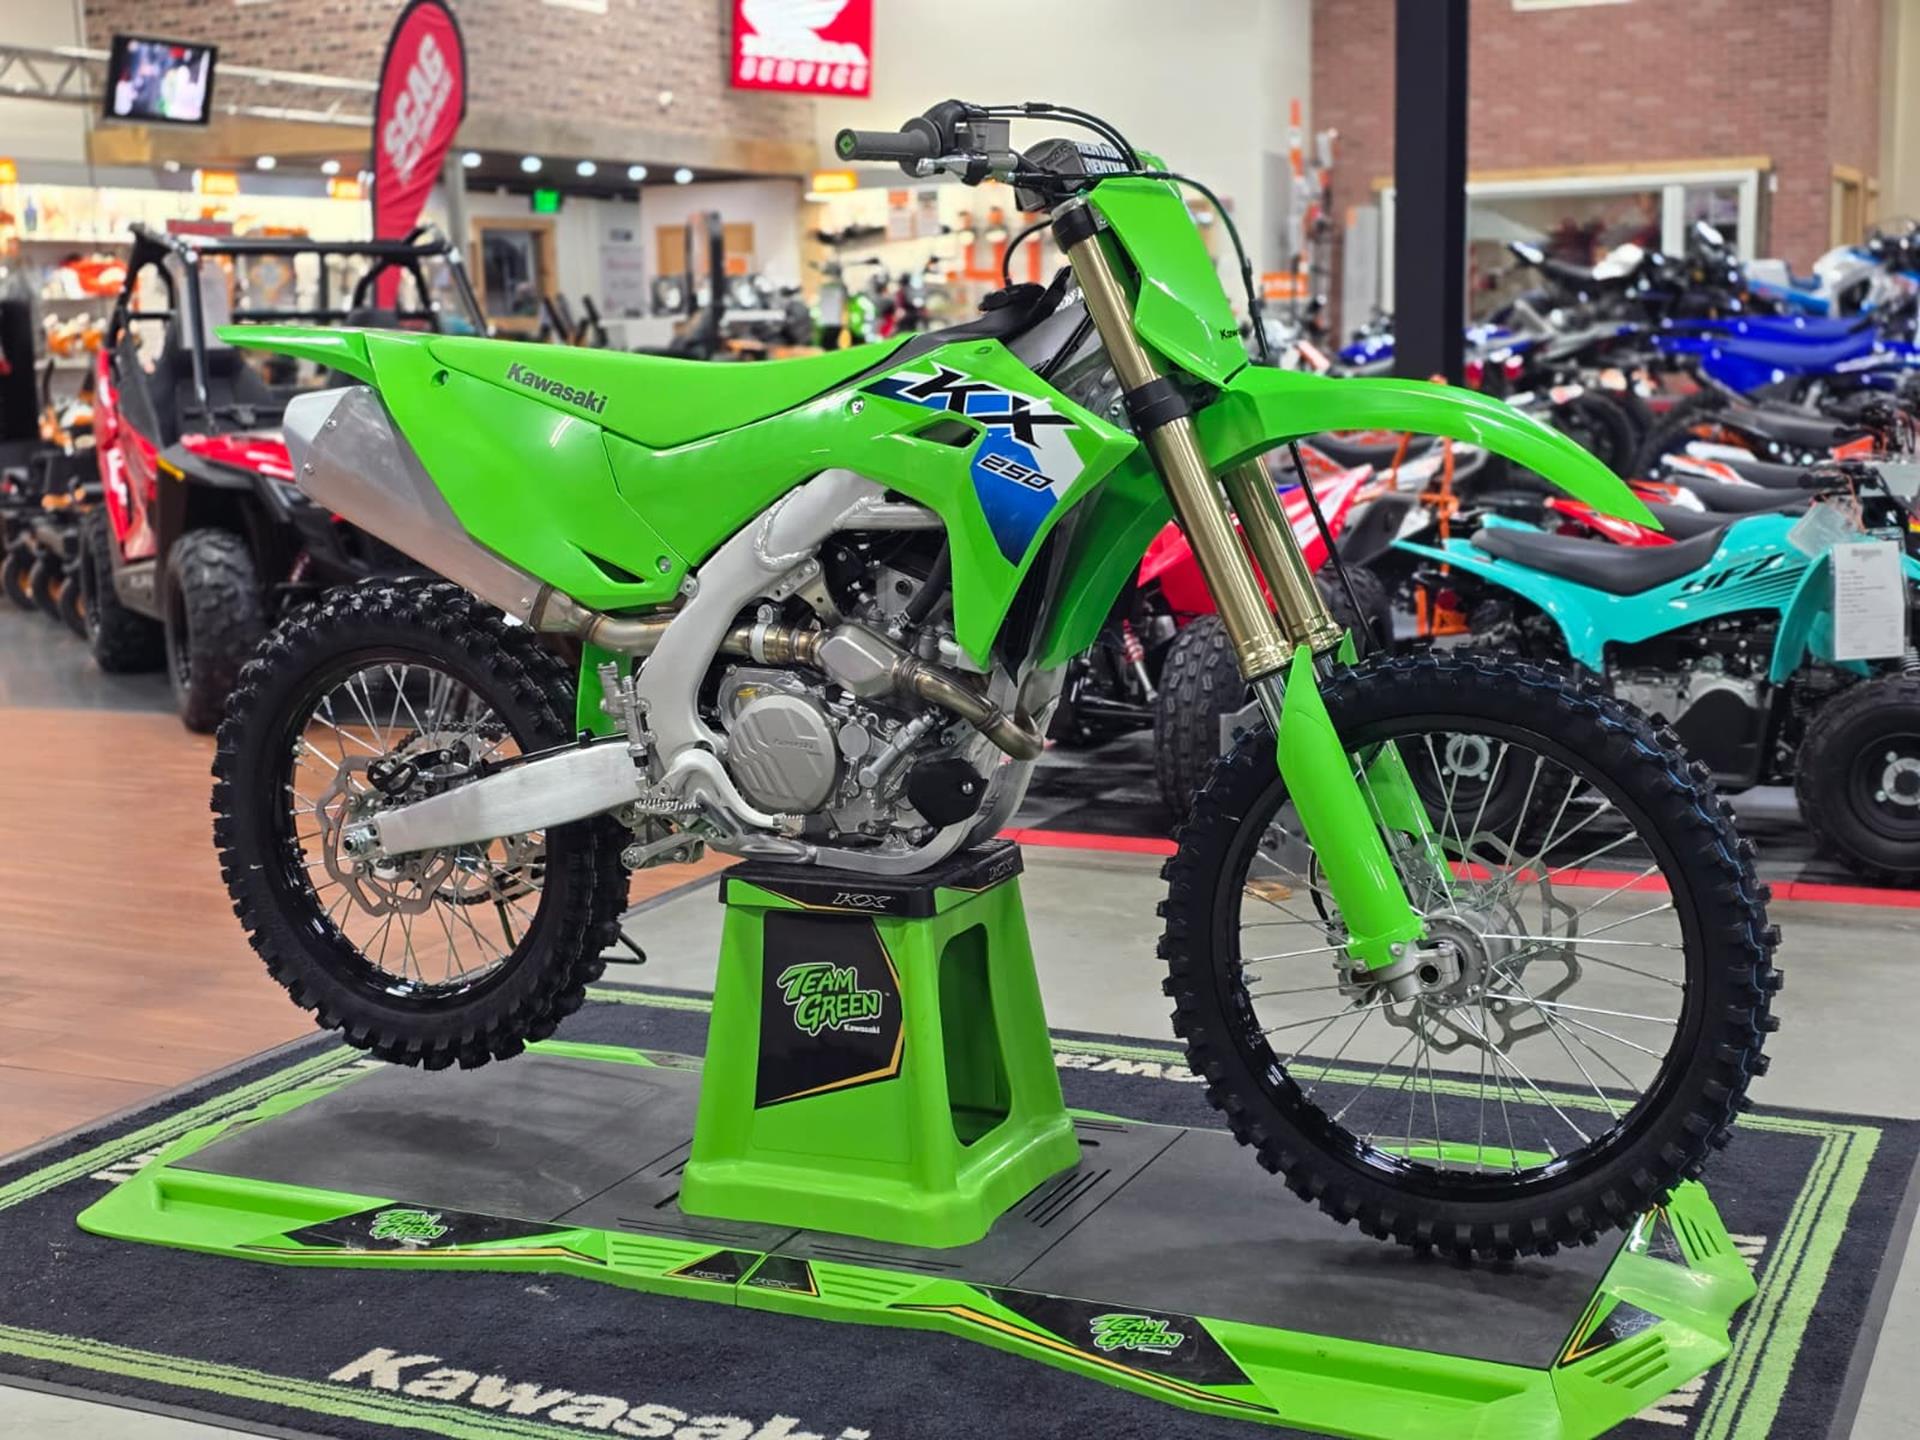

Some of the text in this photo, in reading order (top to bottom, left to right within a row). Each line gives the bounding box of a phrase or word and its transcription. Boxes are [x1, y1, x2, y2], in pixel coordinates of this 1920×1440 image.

[1082, 158, 1130, 174] RENTHA
[506, 362, 608, 414] Kawasaki
[897, 363, 1079, 450] KX
[978, 453, 1055, 492] 250
[832, 892, 892, 909] KX
[778, 963, 856, 1003] TEAM
[796, 992, 881, 1034] GREEN
[843, 1023, 880, 1034] Kawasaki
[369, 1224, 448, 1240] GREEN
[1090, 1313, 1169, 1333] TEAM
[1094, 1330, 1184, 1351] GREEN
